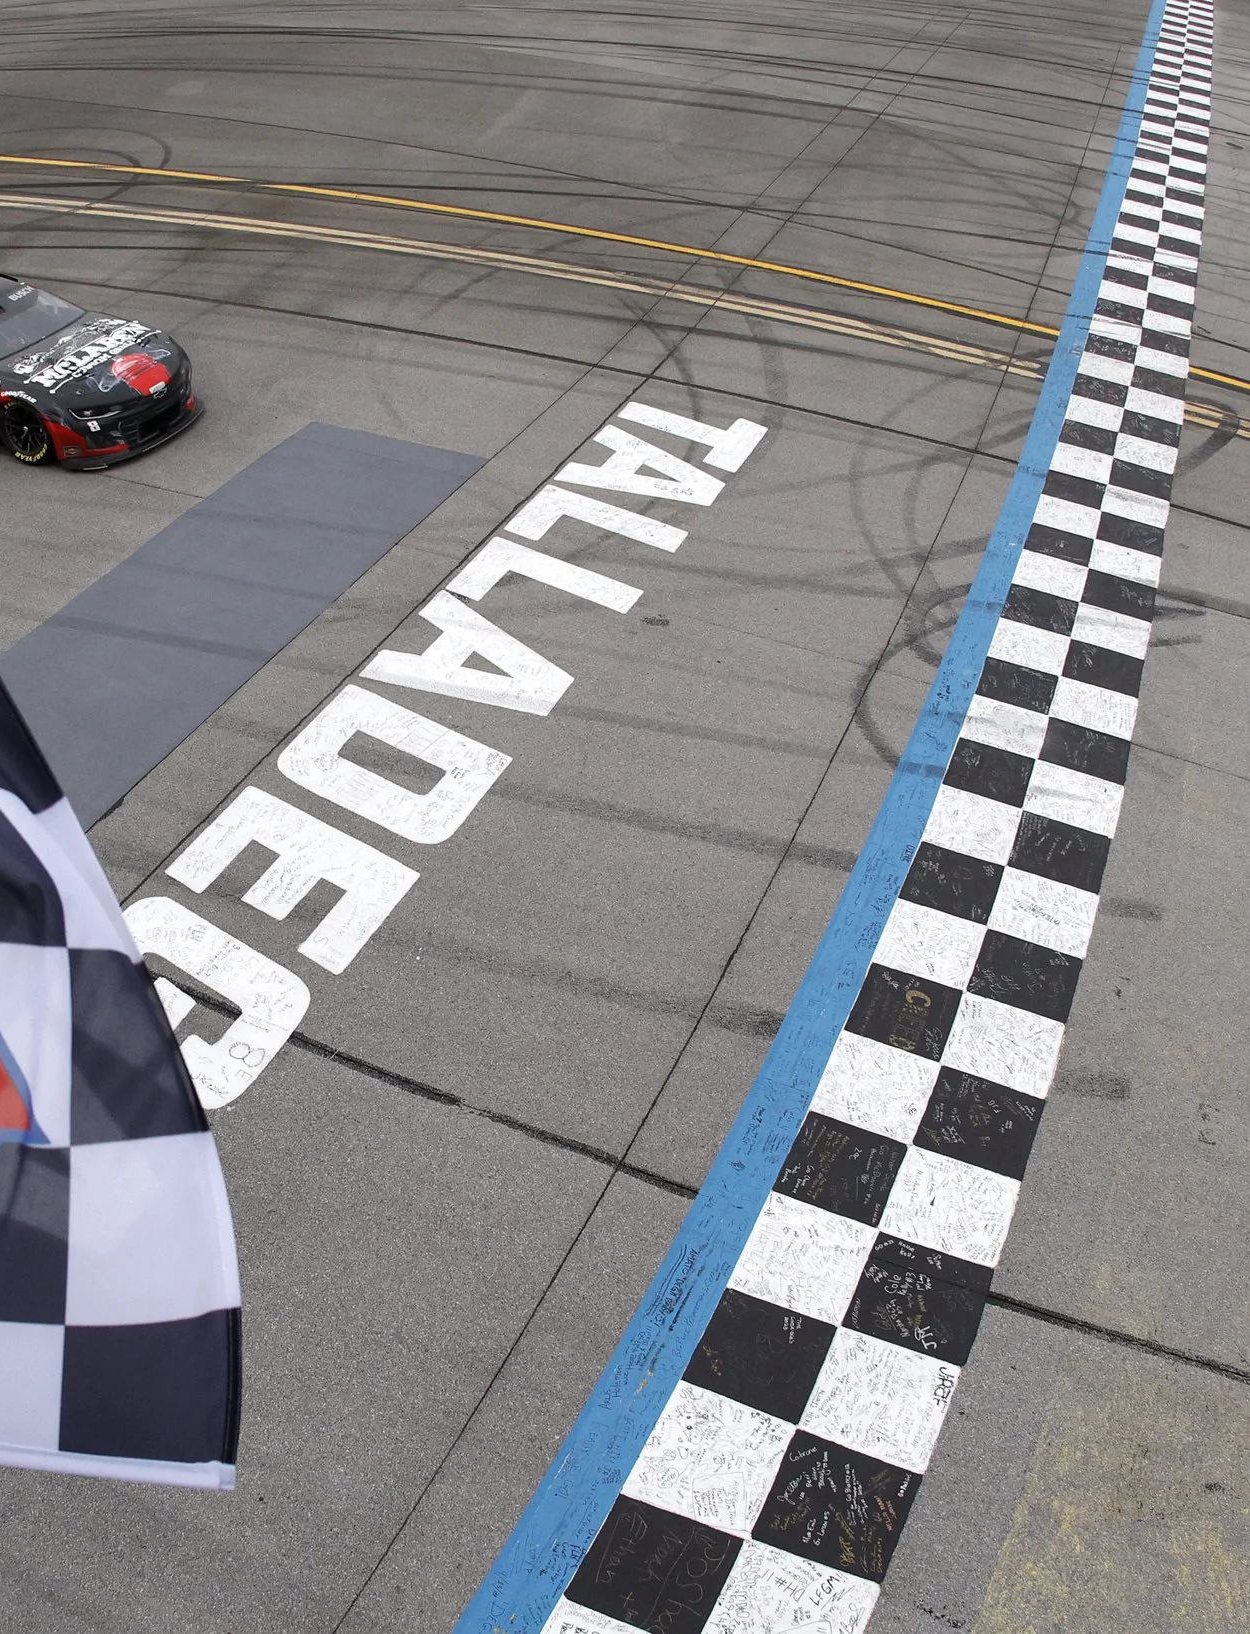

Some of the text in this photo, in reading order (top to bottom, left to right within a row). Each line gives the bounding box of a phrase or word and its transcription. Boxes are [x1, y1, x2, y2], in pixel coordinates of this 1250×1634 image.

[8, 285, 35, 301] BUSCH
[31, 321, 151, 388] MCLAREN
[0, 390, 38, 403] GOODYEAR
[86, 420, 100, 432] 8
[125, 402, 768, 1110] TALLADEG
